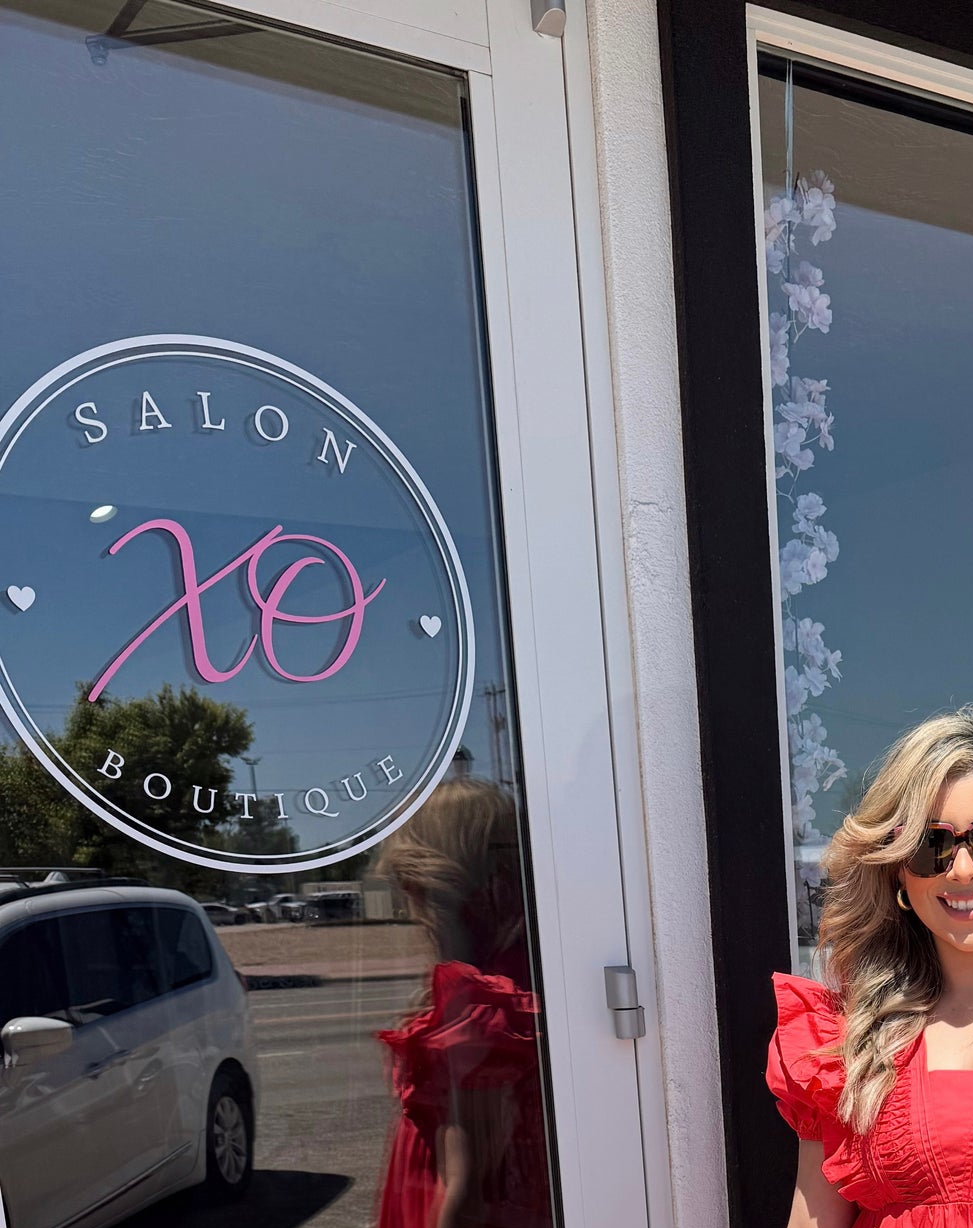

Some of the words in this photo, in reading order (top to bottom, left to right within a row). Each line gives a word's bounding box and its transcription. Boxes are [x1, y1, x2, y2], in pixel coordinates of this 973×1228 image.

[75, 391, 357, 474] SALON
[88, 518, 387, 703] XO
[96, 748, 404, 819] BOUTIQUE
